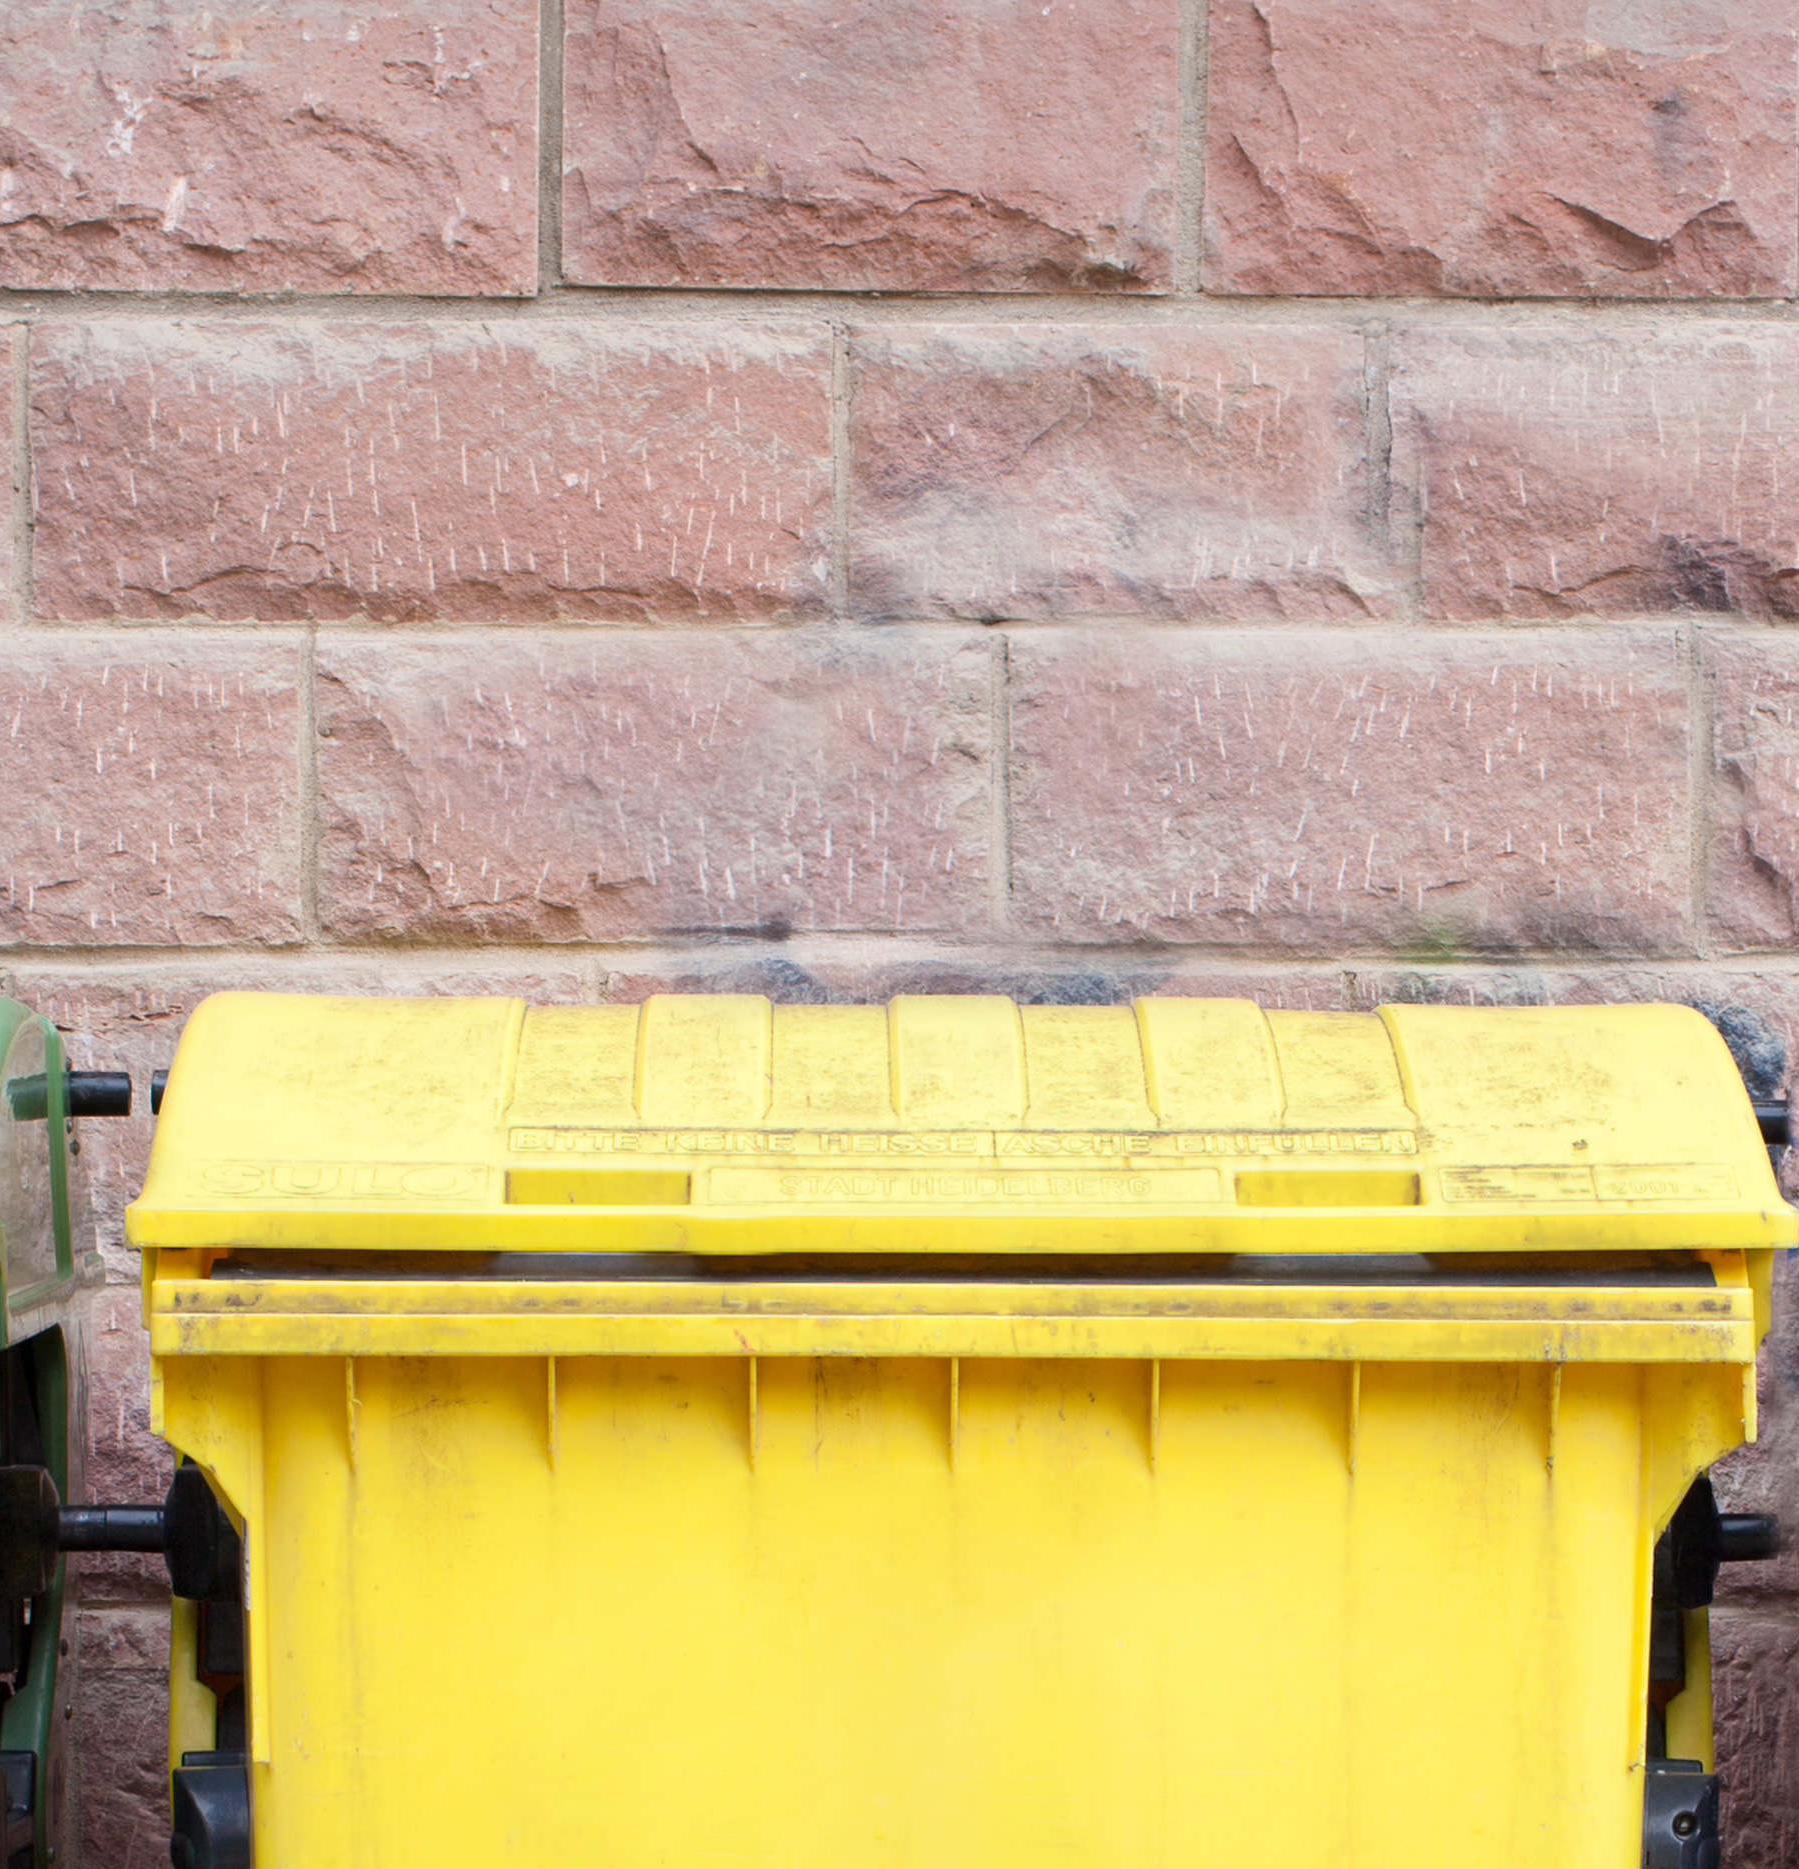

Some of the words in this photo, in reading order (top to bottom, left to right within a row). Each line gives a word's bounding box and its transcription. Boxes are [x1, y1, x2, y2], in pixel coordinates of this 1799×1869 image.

[514, 1129, 641, 1152] BITTE
[665, 1131, 795, 1153] KEINE
[817, 1132, 978, 1154] HEISSE
[1003, 1132, 1152, 1155] ASCHE
[1173, 1130, 1412, 1154] EINFÜLLEN
[199, 1163, 480, 1198] SULO
[779, 1175, 899, 1197] STADT
[910, 1175, 1153, 1197] HEIDELBERG
